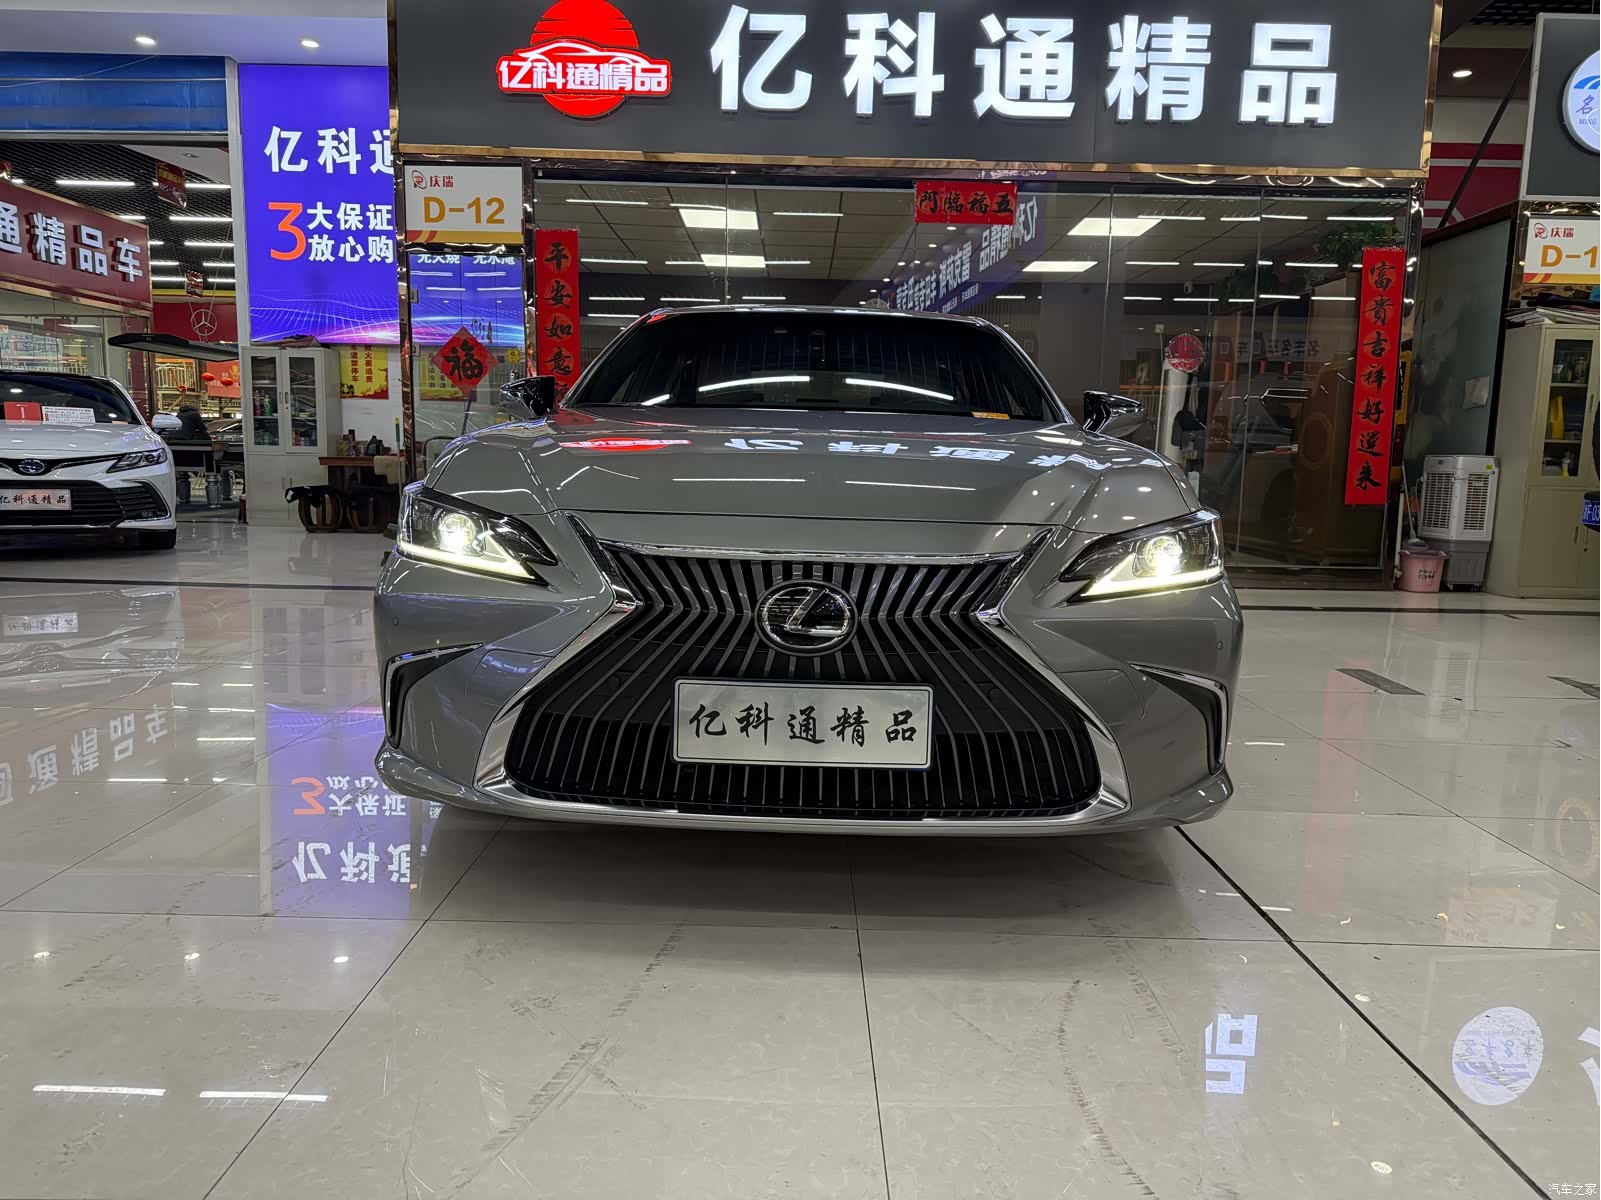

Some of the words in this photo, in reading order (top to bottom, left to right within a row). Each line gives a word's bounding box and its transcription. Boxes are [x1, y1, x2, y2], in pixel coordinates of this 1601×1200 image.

[499, 60, 669, 93] 亿科通精品
[710, 4, 1337, 125] 亿科通精品
[268, 201, 307, 261] 3
[307, 201, 394, 232] 大保证
[423, 196, 505, 225] D-12
[308, 235, 394, 264] 放心购
[443, 338, 484, 382] 福
[689, 701, 917, 748] 亿科通精品
